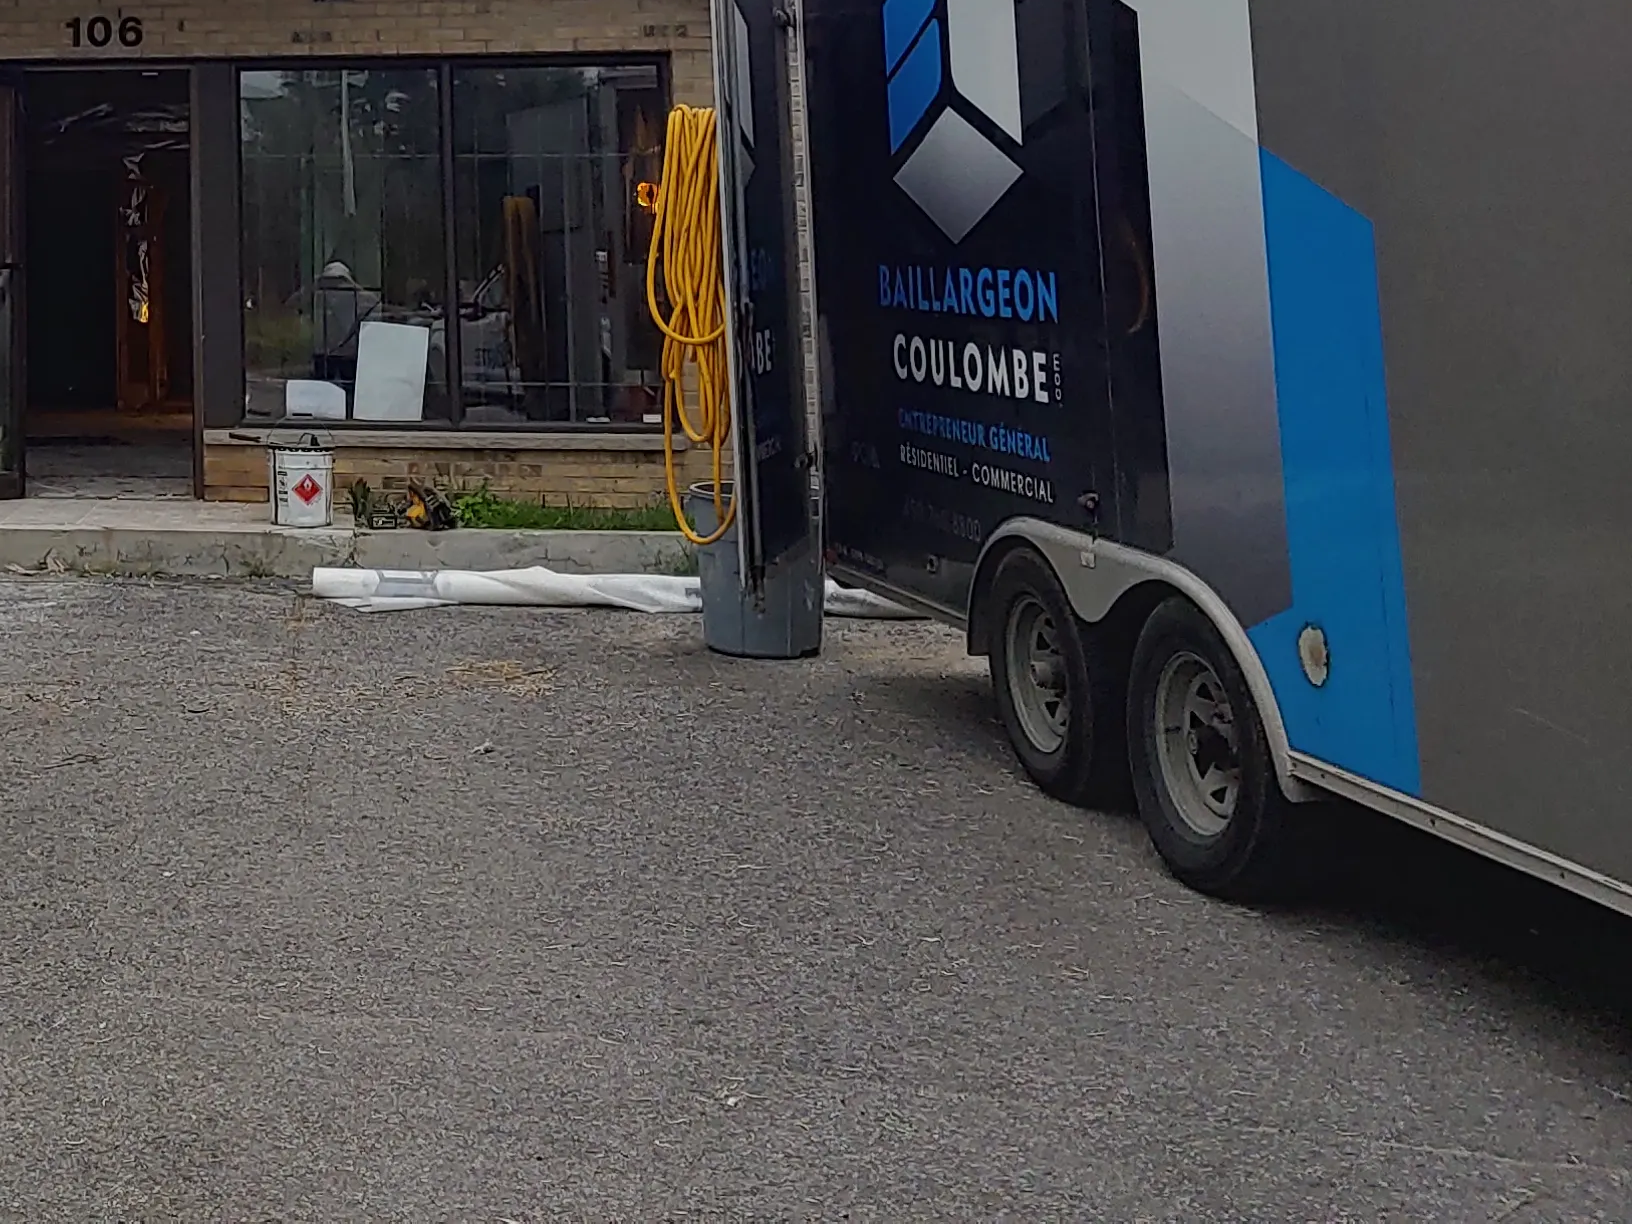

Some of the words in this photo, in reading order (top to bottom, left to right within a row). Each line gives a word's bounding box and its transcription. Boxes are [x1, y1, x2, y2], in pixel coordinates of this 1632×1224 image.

[65, 16, 144, 47] 106
[877, 264, 1059, 324] BAILLARGEON
[893, 333, 1050, 404] COULOMBE
[897, 407, 986, 449] ENTREPRENEUR
[989, 420, 1052, 464] GÉNÉRAL
[899, 441, 960, 478] RÉSIDENTIEL
[971, 462, 1055, 504] COMMERCIAL
